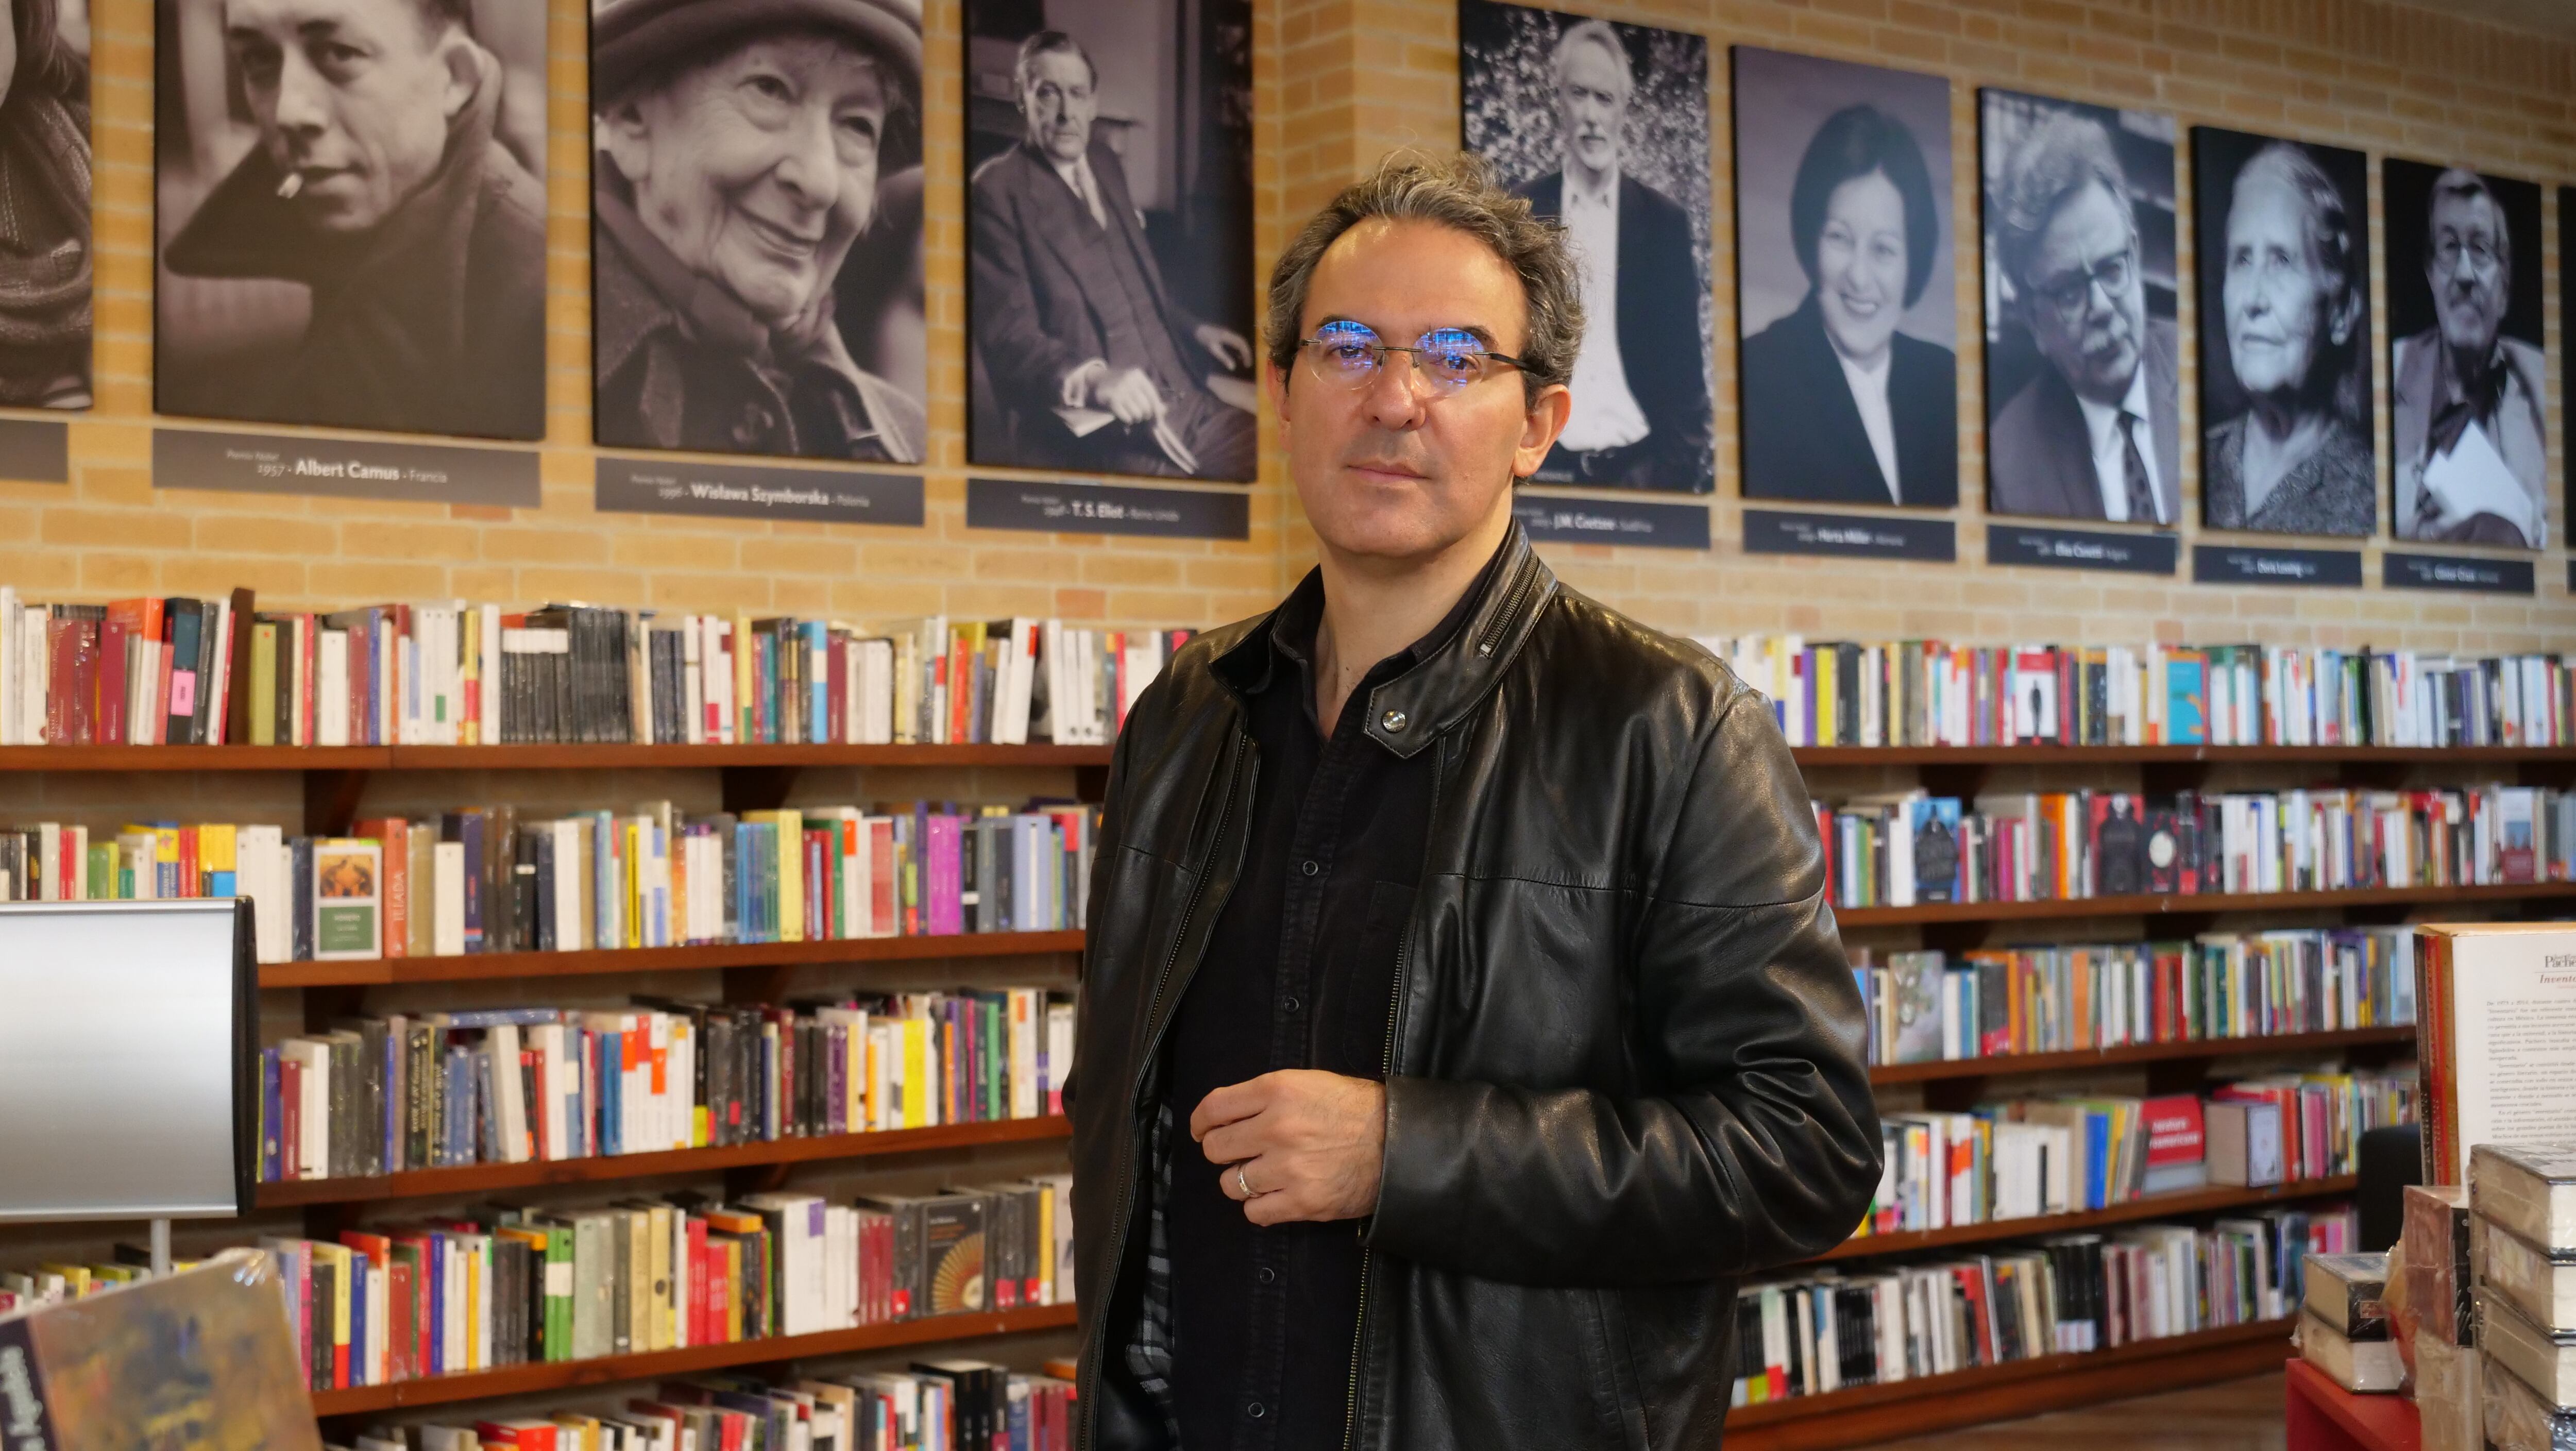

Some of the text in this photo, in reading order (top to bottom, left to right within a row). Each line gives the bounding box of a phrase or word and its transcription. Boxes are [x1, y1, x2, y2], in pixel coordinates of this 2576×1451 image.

[258, 458, 447, 483] 1957 Albert Camus Francia
[751, 484, 828, 507] Szymborska
